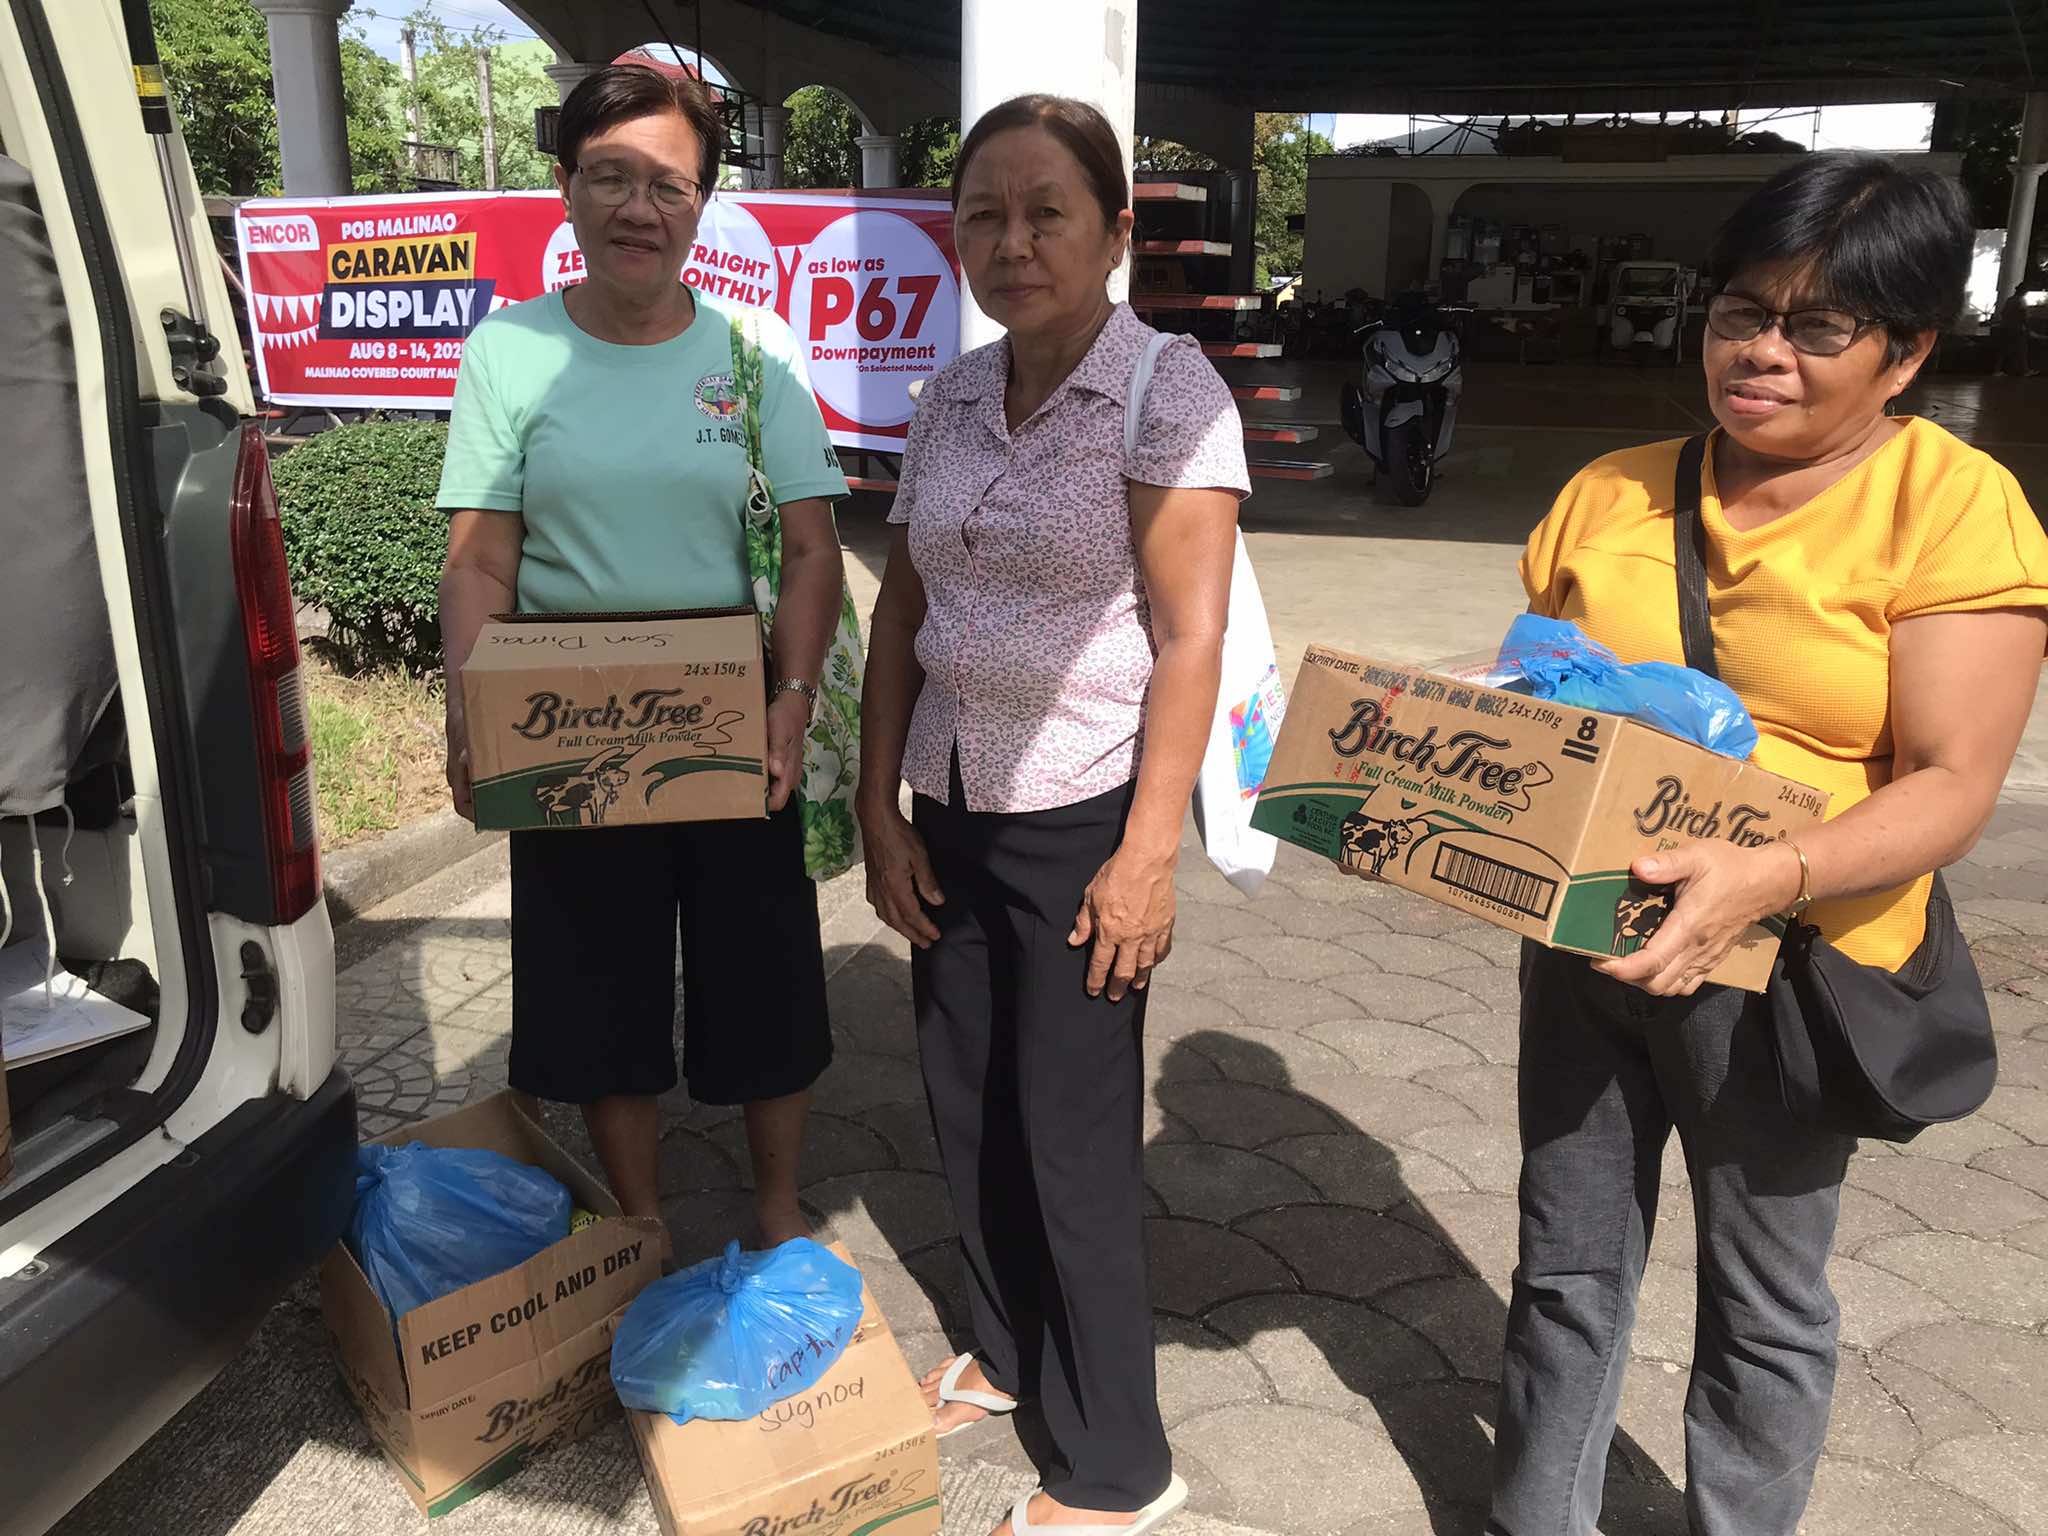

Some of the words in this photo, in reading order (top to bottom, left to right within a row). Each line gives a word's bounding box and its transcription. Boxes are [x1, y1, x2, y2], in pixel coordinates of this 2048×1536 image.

[248, 223, 311, 244] EMCOR
[341, 218, 375, 240] POB
[377, 213, 457, 237] MALINAO
[332, 240, 470, 280] CARAVAN
[557, 249, 584, 274] ZE
[689, 243, 771, 281] RAIGHT
[808, 261, 828, 274] as
[831, 257, 861, 273] low
[864, 258, 885, 272] as
[682, 267, 773, 307] ONTHLY
[331, 288, 477, 328] DISPLAY
[809, 274, 941, 342] P67
[350, 342, 386, 359] AUG
[388, 342, 397, 359] 8
[410, 342, 431, 362] 14,
[811, 343, 936, 363] Downpayment
[870, 364, 905, 373] Selected
[905, 363, 934, 373] Models
[305, 367, 350, 378] MALINAO
[351, 367, 399, 379] COVERED
[400, 367, 435, 379] COURT
[696, 428, 717, 443] J.T.
[1308, 652, 1337, 669] EXPIRY
[1334, 659, 1361, 674] DATE:
[511, 690, 624, 741] Birch
[624, 687, 704, 728] Tree
[1577, 716, 1598, 741] 8
[557, 735, 582, 748] Full
[585, 734, 625, 746] Cream
[629, 732, 655, 745] Milk
[659, 730, 703, 743] Powder
[1328, 697, 1438, 773] Birch
[1427, 730, 1525, 795] Tree
[1358, 761, 1383, 781] Full
[1383, 769, 1424, 794] Cream
[1425, 781, 1458, 805] Milk
[1457, 792, 1510, 821] Powder
[1633, 775, 1722, 838] Birch
[421, 1322, 482, 1366] KEEP
[490, 1292, 549, 1335] COOL
[555, 1264, 597, 1302] AND
[603, 1240, 643, 1277] DRY
[475, 1376, 570, 1442] Birch
[827, 1472, 893, 1517] Tree
